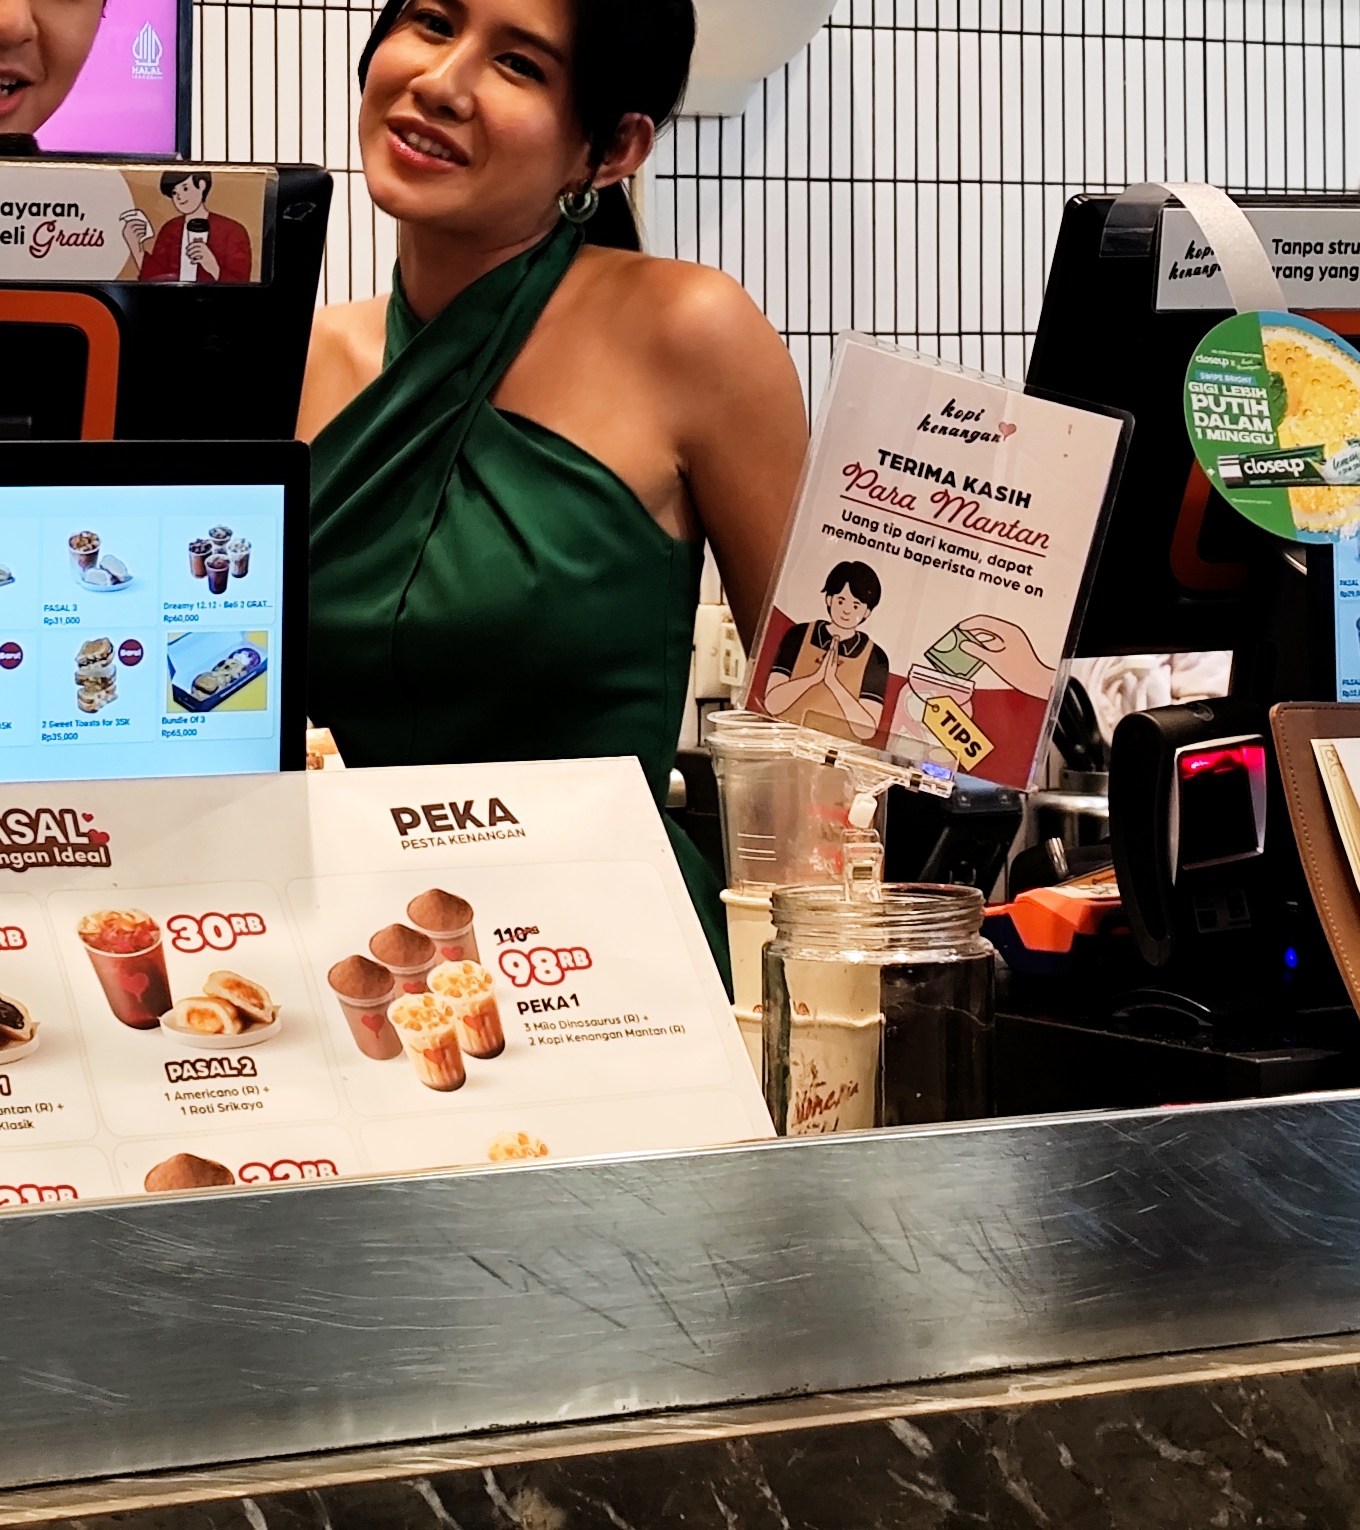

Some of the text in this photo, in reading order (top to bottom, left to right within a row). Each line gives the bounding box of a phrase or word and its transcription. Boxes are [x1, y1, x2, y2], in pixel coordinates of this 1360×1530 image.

[28, 219, 106, 259] Gratis
[1184, 239, 1215, 260] kop
[1271, 238, 1325, 258] Tanpa
[1168, 262, 1222, 281] kenang
[1273, 264, 1314, 282] rang
[1318, 265, 1359, 282] yang
[1188, 381, 1268, 399] GIGI LEBIH
[940, 398, 985, 422] kopi
[1190, 393, 1270, 417] PUTIH
[916, 413, 1002, 444] kenangan
[1193, 412, 1274, 433] DALAM
[1195, 428, 1203, 439] 1
[1243, 457, 1305, 477] closeup
[877, 449, 1032, 510] TERIMA KASIH
[841, 461, 1051, 551] Para Mantan
[840, 508, 1034, 577] Uang tip dari kamu, dapat
[821, 522, 1044, 599] membantu baperista move on
[938, 710, 983, 759] TIPS
[390, 797, 520, 836] PEKA
[401, 827, 526, 850] PESTA KENANGAN
[53, 846, 107, 864] Ideal
[524, 1013, 640, 1033] 3 Milo Dinosaurus (R)
[528, 1024, 686, 1046] 2 Kopi Kenangan Mantan (R)
[164, 1056, 257, 1083] PASAL 2
[164, 1085, 260, 1102] 1 Americano (R)
[35, 1102, 53, 1113] (R)
[180, 1101, 264, 1116] 1 Roti Srikaya
